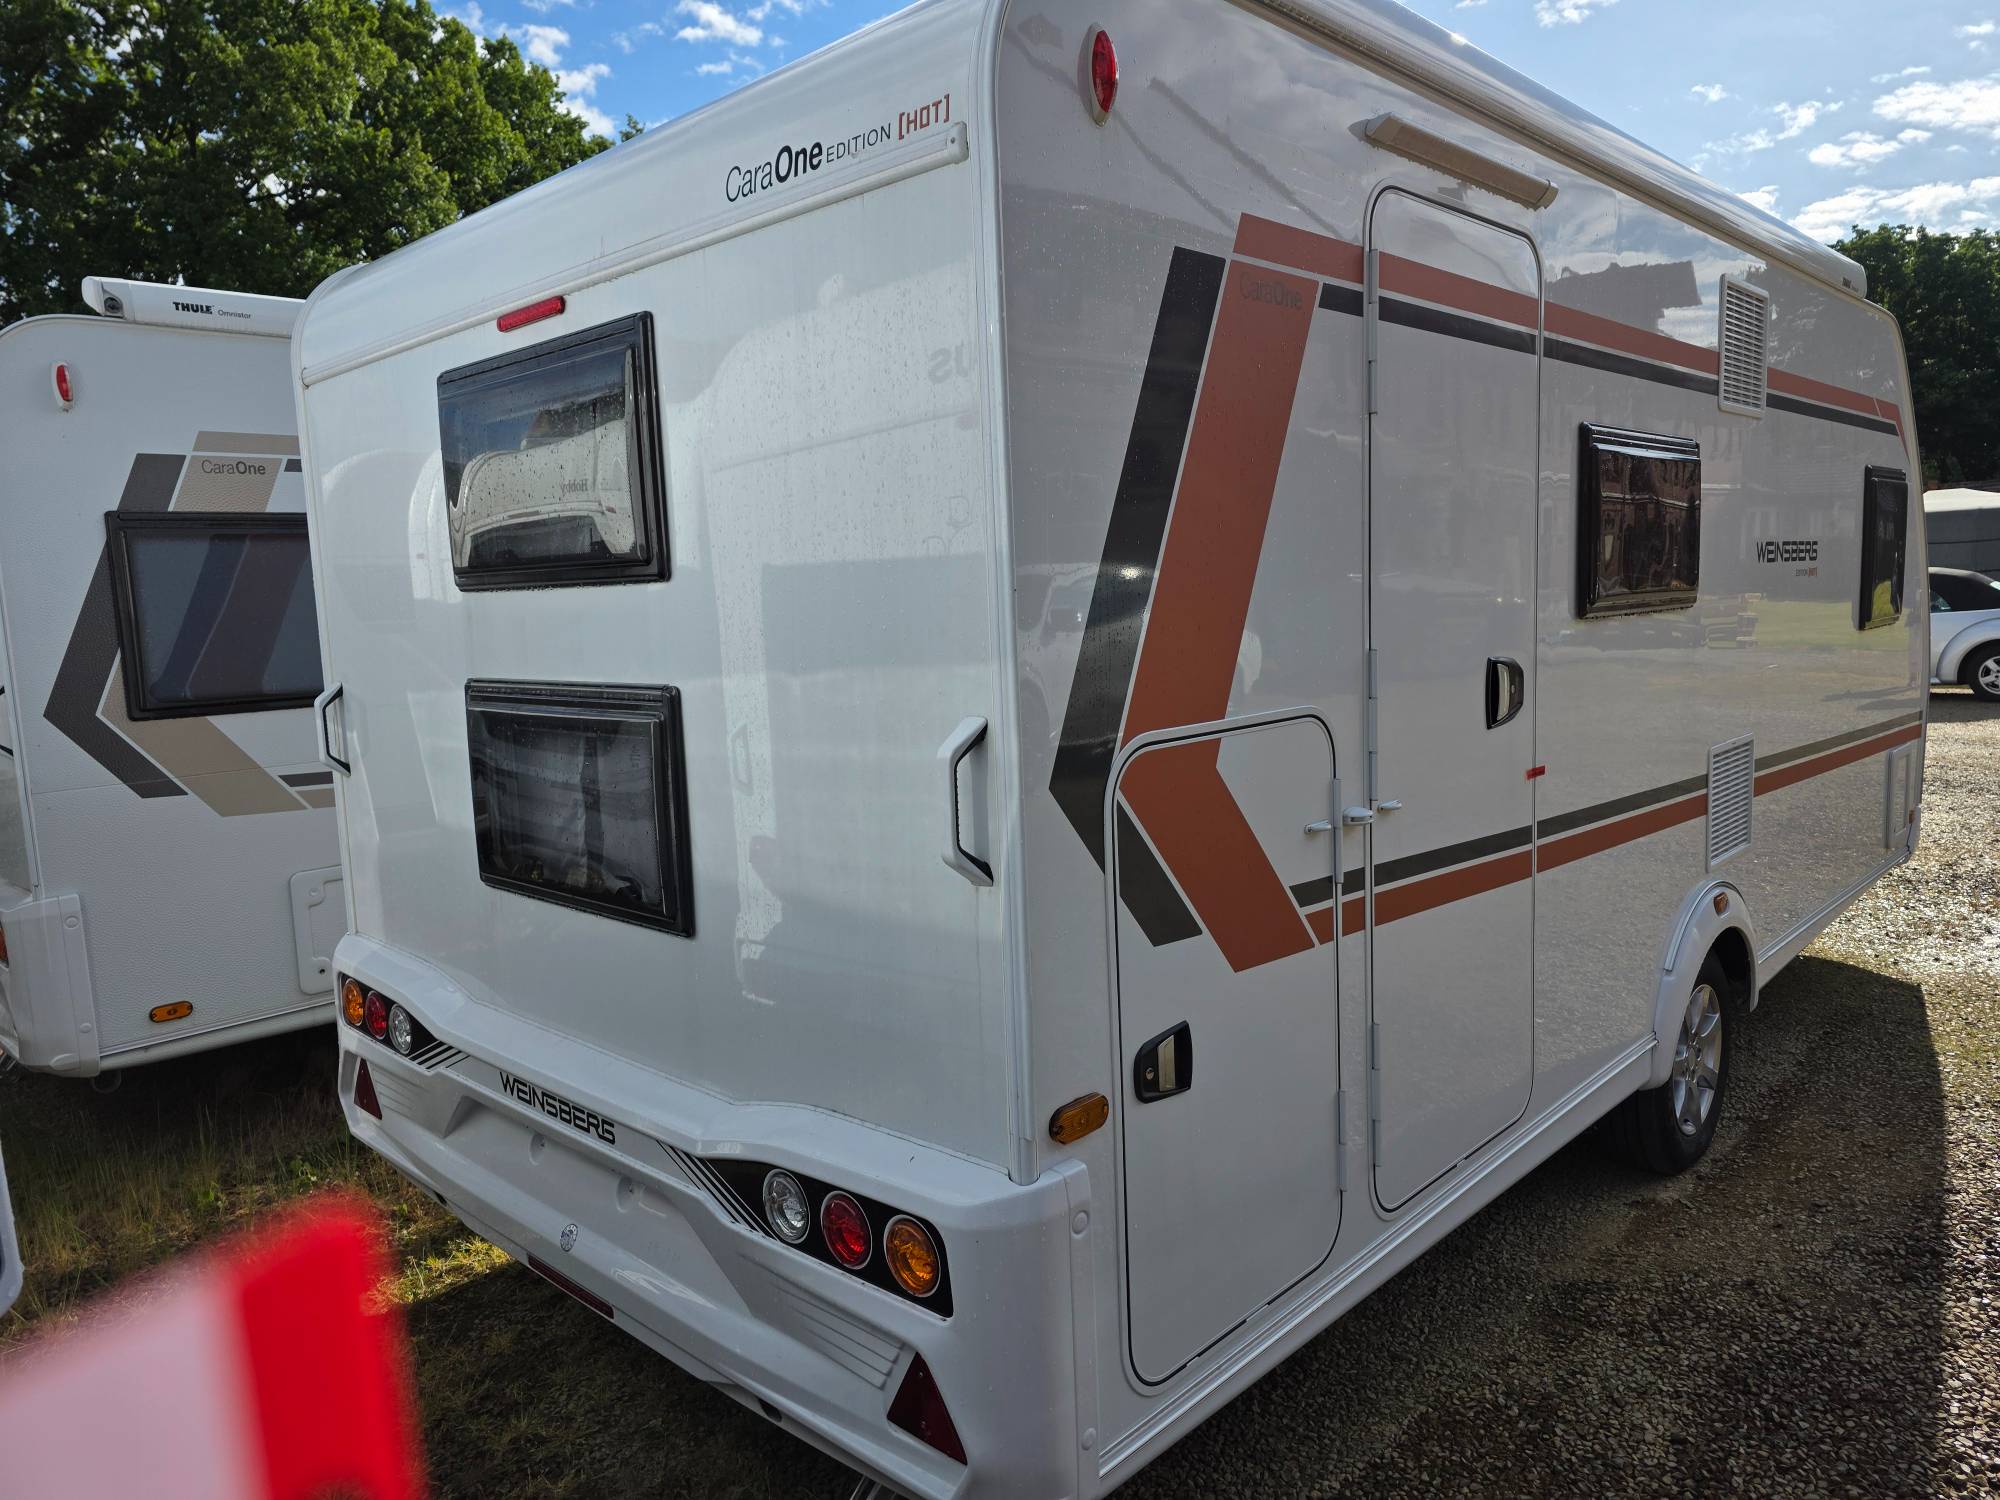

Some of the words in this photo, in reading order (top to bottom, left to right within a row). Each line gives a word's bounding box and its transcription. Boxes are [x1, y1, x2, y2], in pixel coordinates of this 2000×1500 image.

[725, 142, 822, 202] CaraOne
[825, 123, 891, 163] EDITION
[897, 93, 950, 140] [HOT]
[1241, 272, 1303, 310] CaraOne
[172, 301, 213, 315] THULE
[217, 309, 252, 320] Omnistor
[201, 459, 266, 475] CaraOne
[1756, 541, 1818, 563] WEINSBERG
[500, 1071, 616, 1146] WEINSBERG
